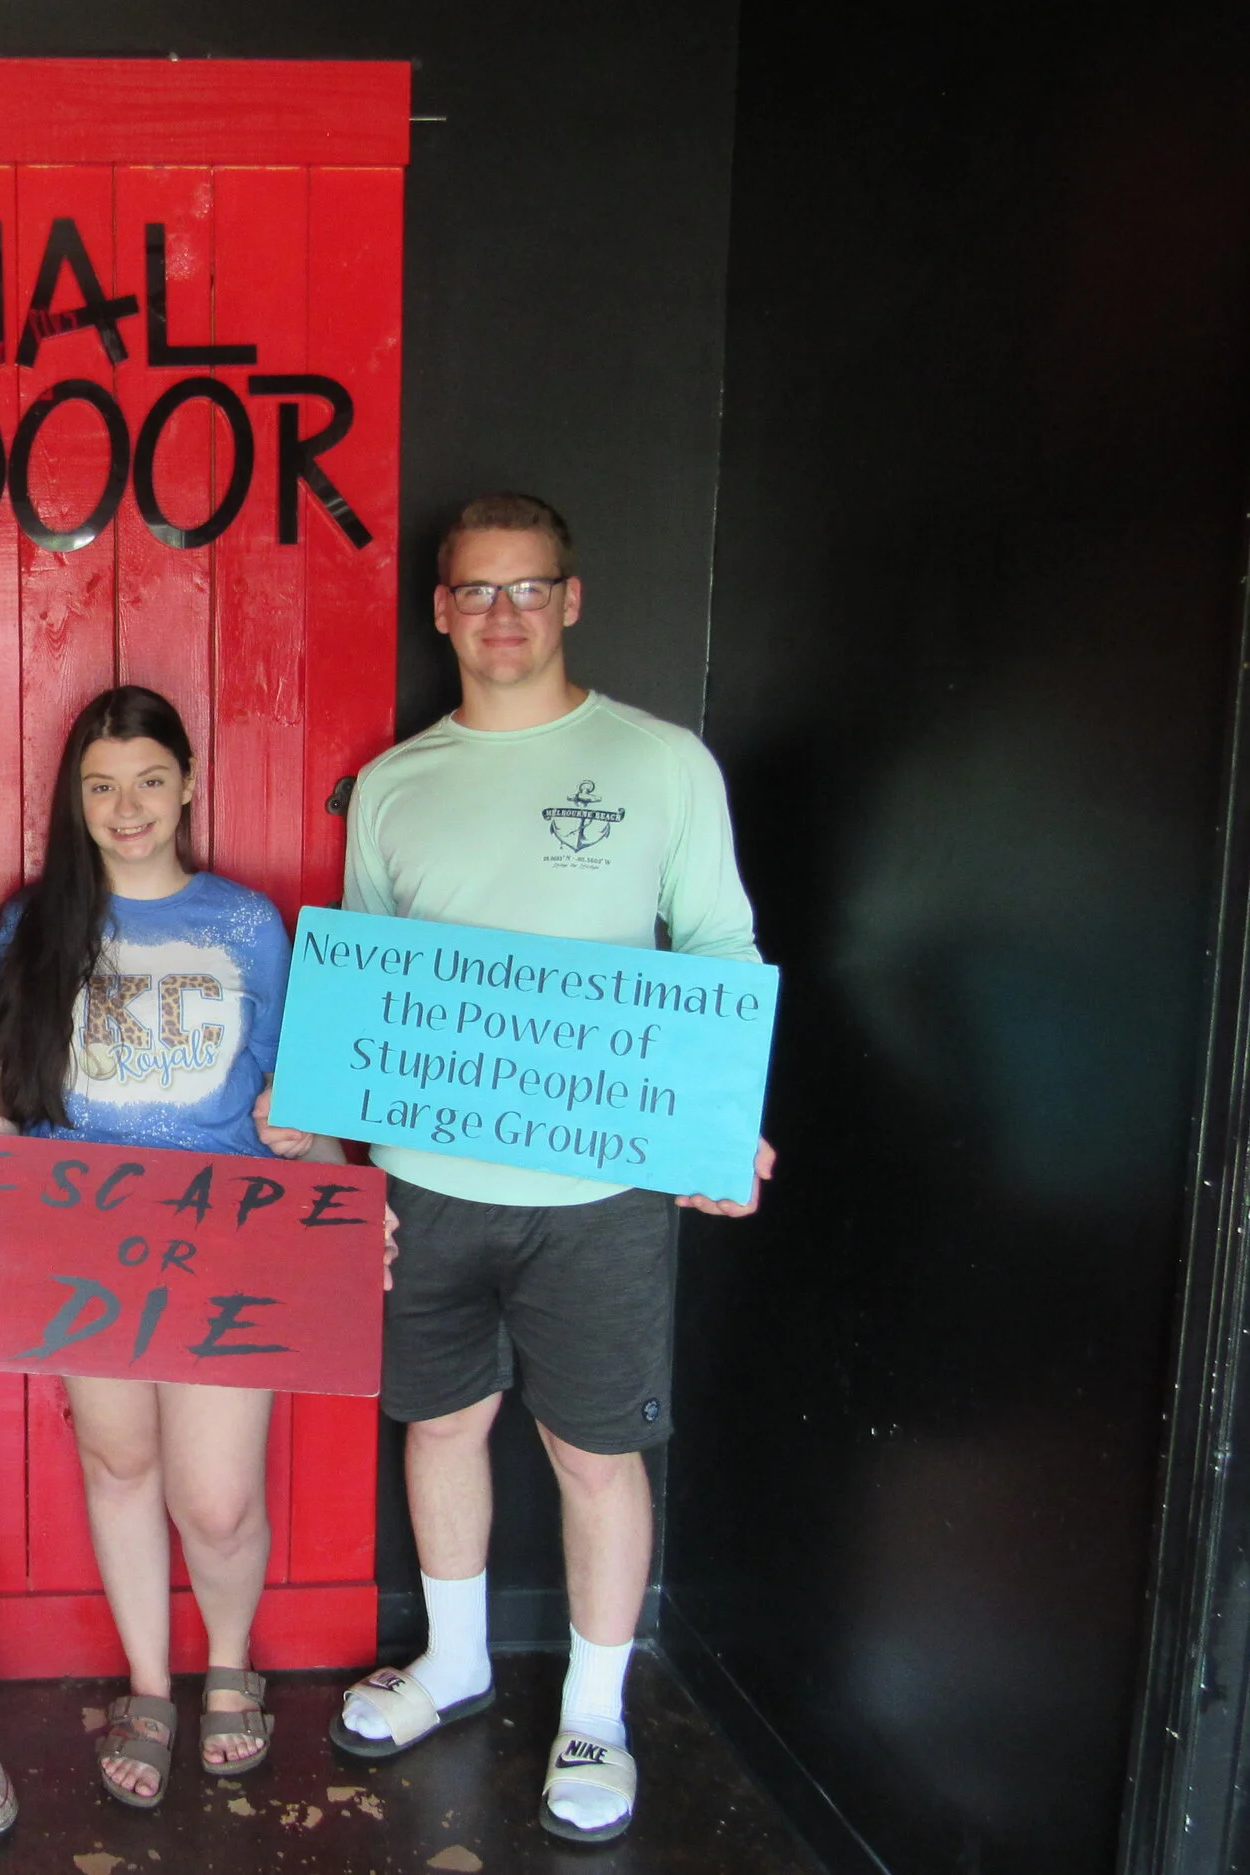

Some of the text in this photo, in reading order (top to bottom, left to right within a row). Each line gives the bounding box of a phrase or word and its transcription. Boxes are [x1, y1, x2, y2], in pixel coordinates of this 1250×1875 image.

[545, 808, 621, 821] MELBOURNE BEACH
[79, 974, 225, 1051] KC
[302, 930, 760, 1023] Never Underestimate
[108, 1028, 219, 1087] Royals
[381, 991, 662, 1060] the Power of
[350, 1037, 676, 1116] Stupid People in
[359, 1089, 649, 1169] Large Groups
[117, 1235, 199, 1275] OR
[0, 1273, 301, 1368] DIE
[564, 1739, 608, 1763] NIKE
